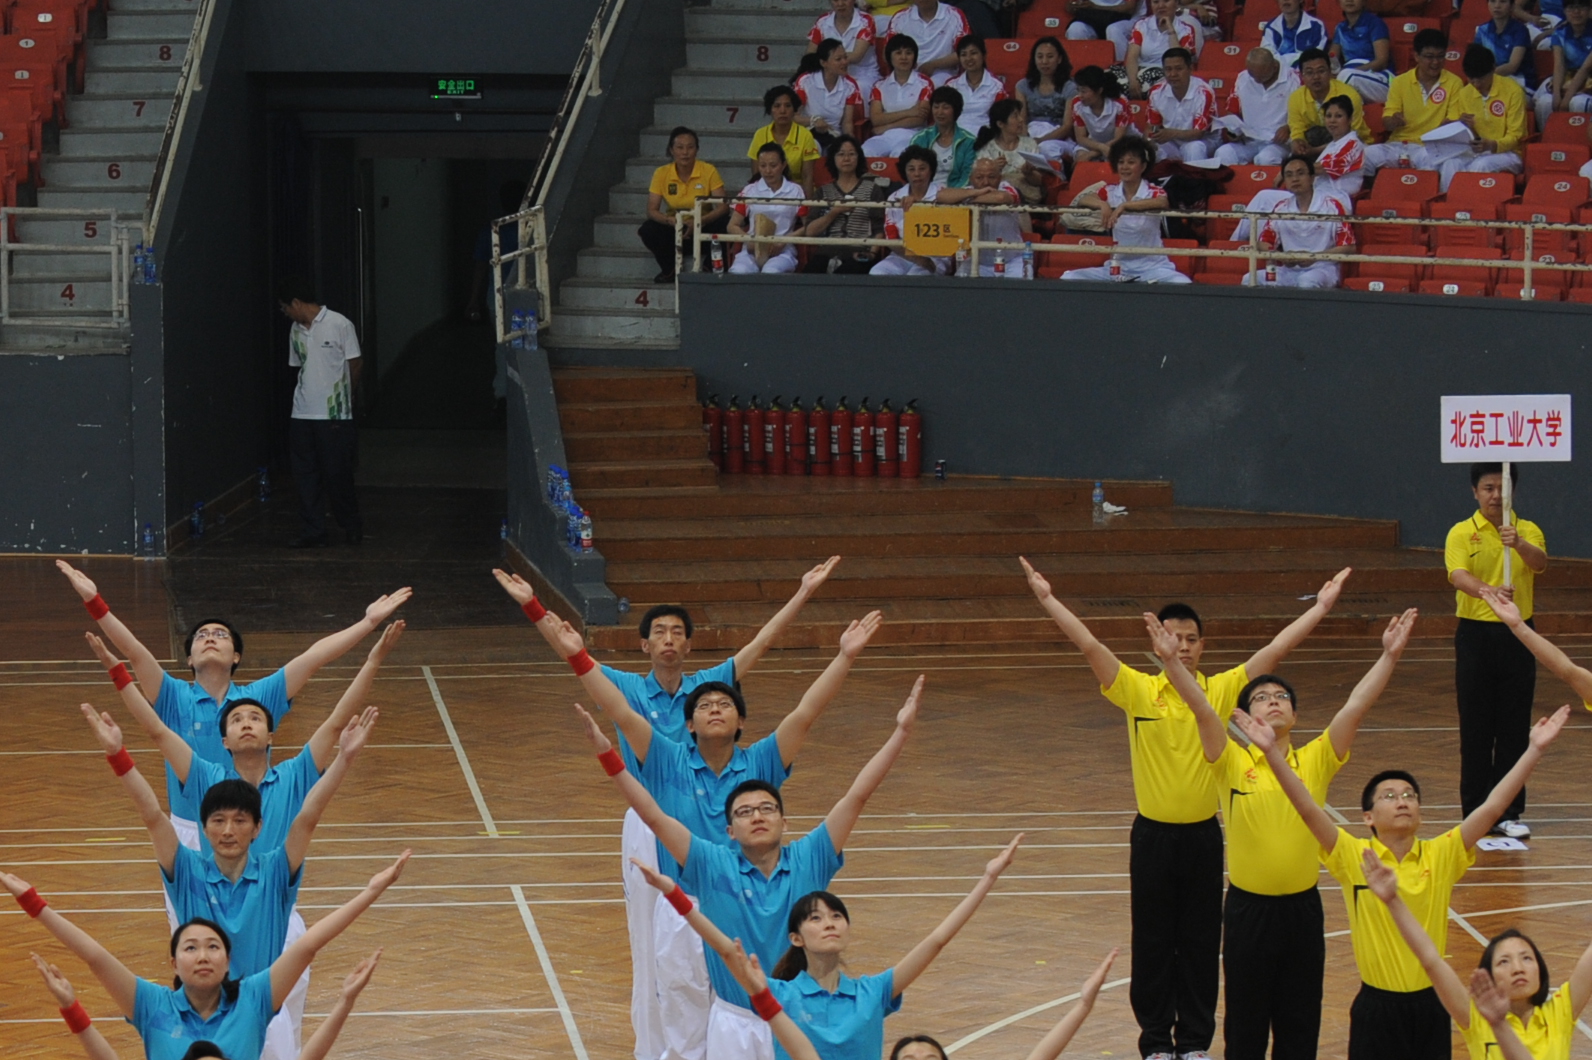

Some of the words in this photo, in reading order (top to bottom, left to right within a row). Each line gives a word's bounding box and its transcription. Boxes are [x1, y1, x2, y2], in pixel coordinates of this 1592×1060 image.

[160, 46, 172, 60] 8
[757, 46, 769, 61] 8
[438, 79, 475, 90] 安全出口
[133, 102, 146, 116] 7
[727, 108, 739, 123] 7
[108, 164, 121, 179] 6
[84, 222, 97, 238] 5
[914, 223, 940, 237] 123
[60, 284, 75, 300] 4
[635, 291, 649, 307] 4
[1450, 410, 1562, 448] 北京工业大学
